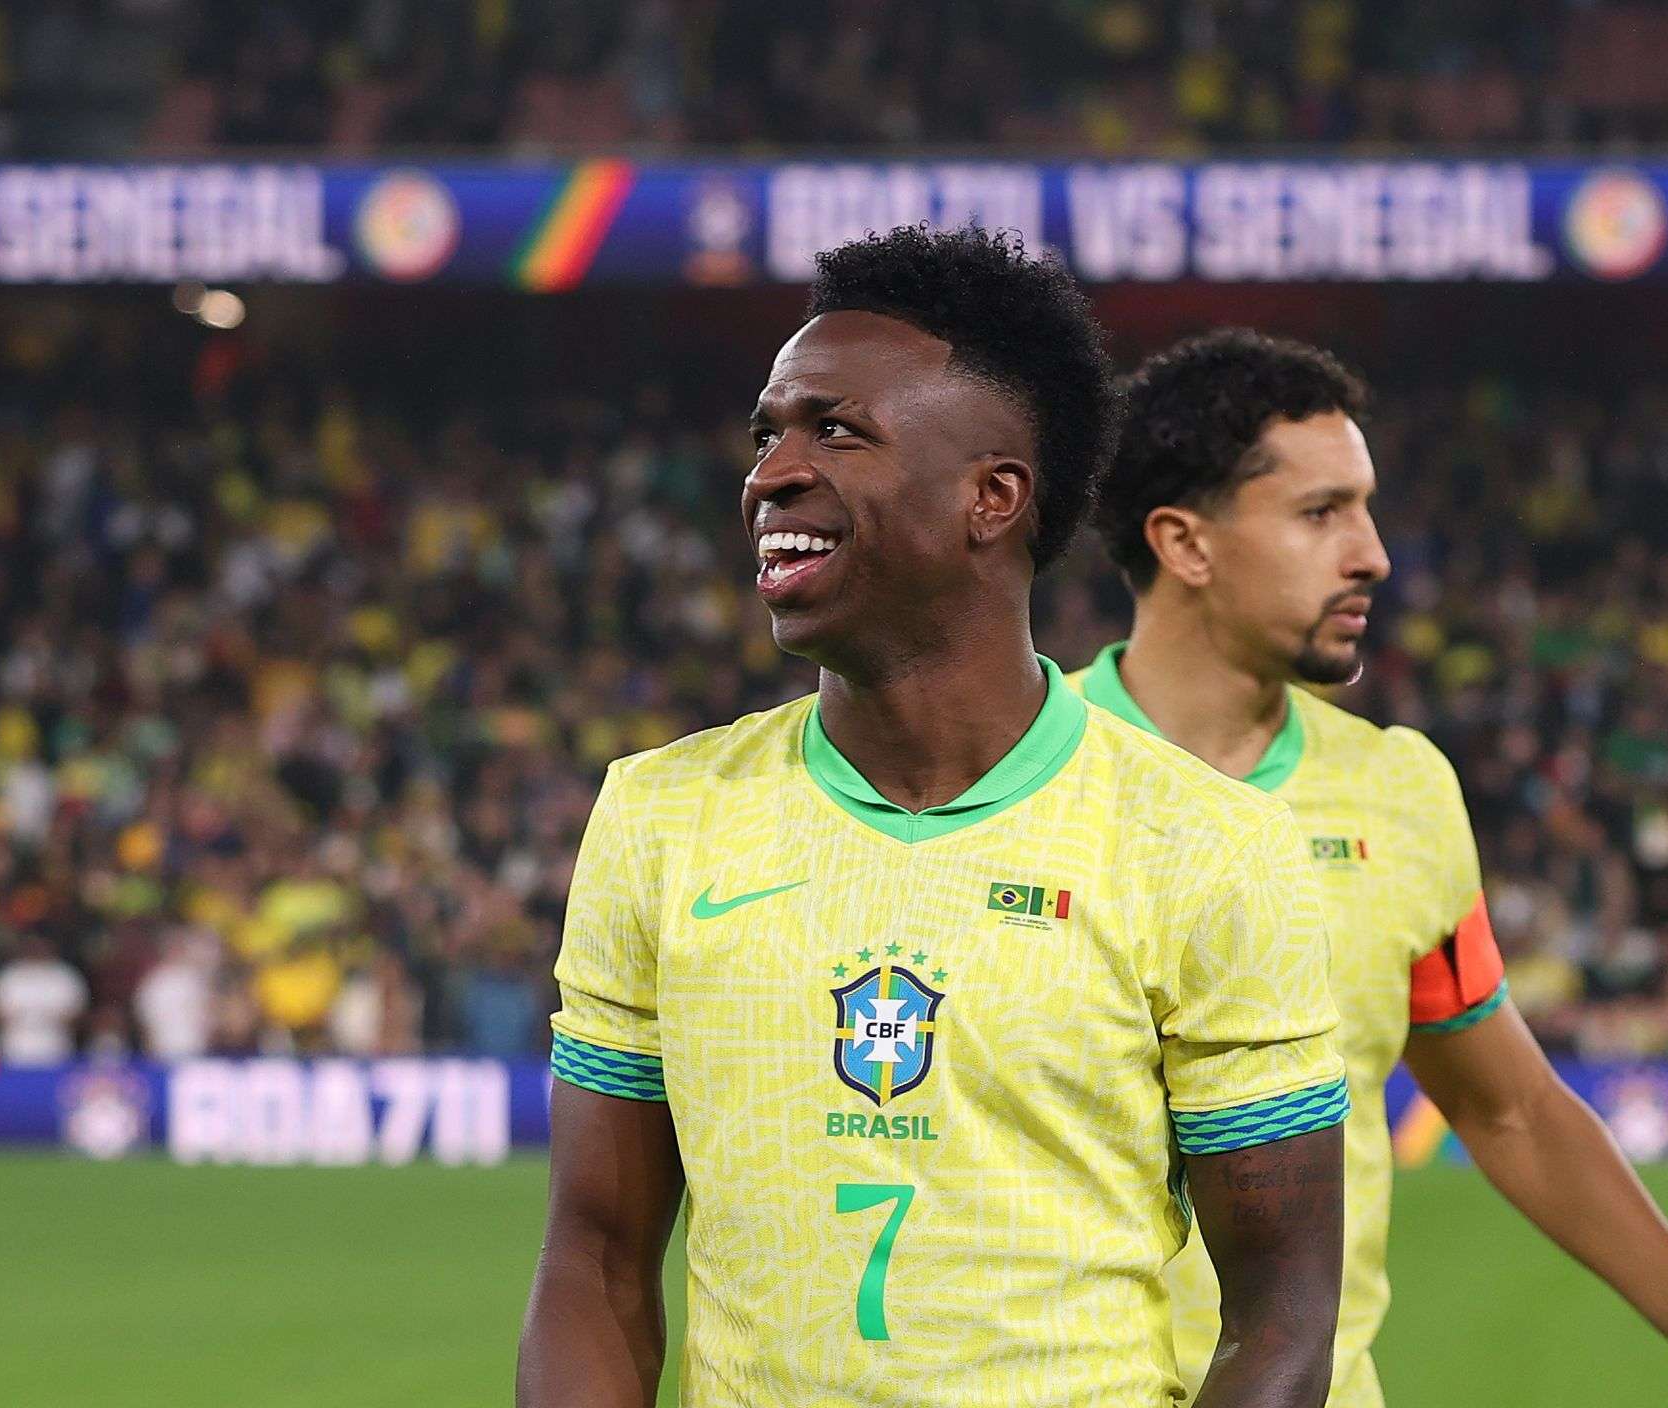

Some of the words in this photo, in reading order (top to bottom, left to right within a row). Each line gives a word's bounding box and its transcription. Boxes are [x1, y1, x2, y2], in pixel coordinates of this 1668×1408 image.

[1066, 163, 1185, 280] VS
[1193, 163, 1555, 280] SENEGAL
[865, 1022, 906, 1039] CBF
[826, 1112, 938, 1141] BRASIL
[835, 1183, 916, 1342] 7
